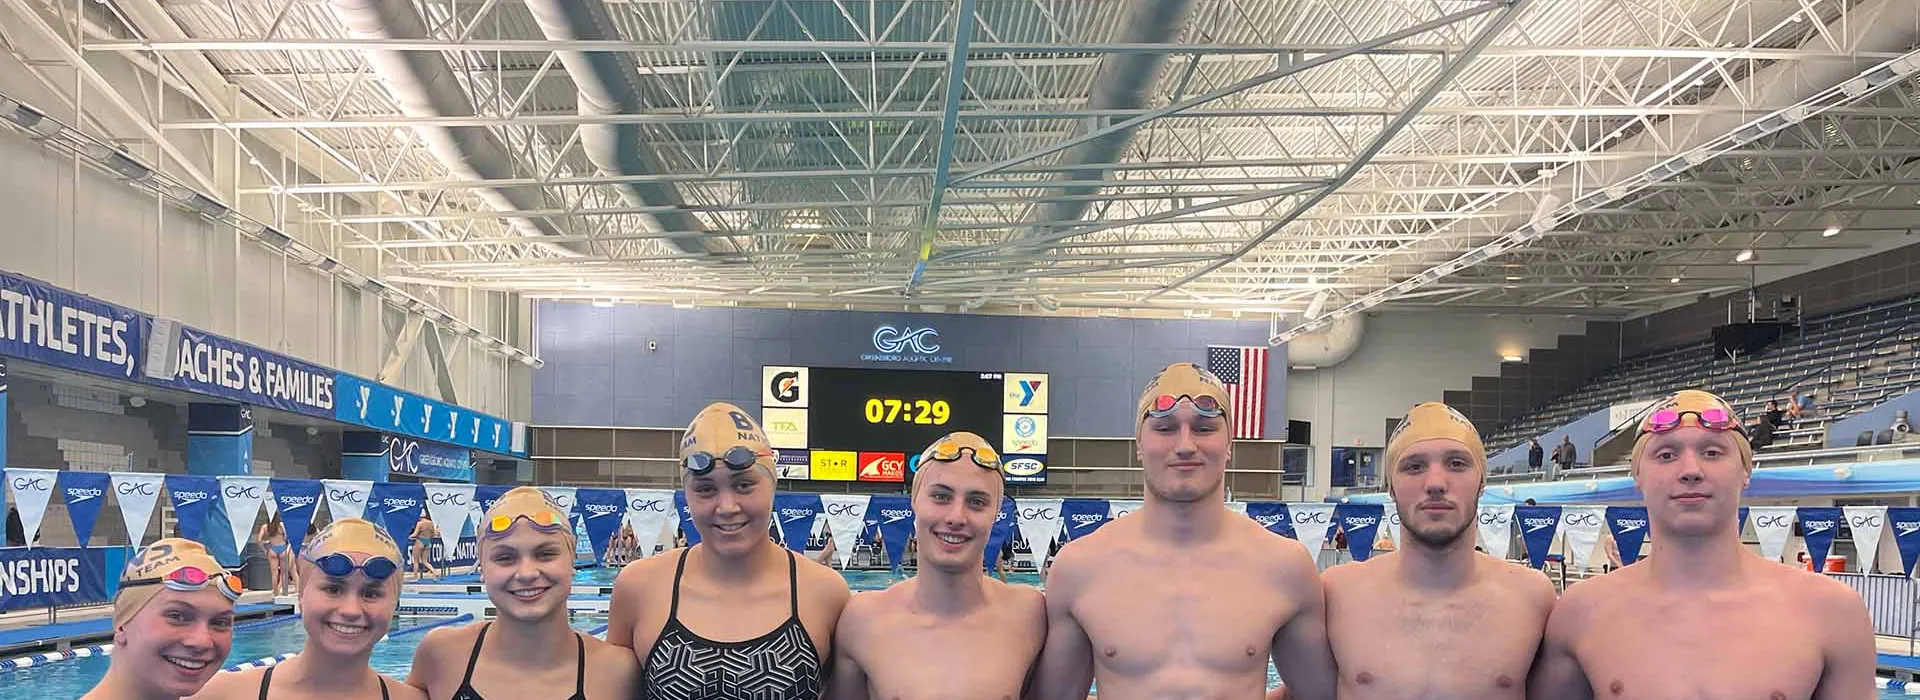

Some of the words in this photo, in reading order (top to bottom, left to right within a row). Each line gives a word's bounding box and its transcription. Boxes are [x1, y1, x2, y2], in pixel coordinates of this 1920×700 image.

[874, 326, 940, 353] GAC
[175, 339, 244, 390] ACHES
[249, 356, 262, 395] &
[266, 361, 333, 410] FAMILIES
[865, 398, 950, 425] 07:29
[882, 460, 904, 471] GCY
[1011, 462, 1038, 470] SFSC
[14, 477, 49, 491] GAC
[117, 482, 154, 496] GAC
[67, 487, 102, 498] speedo
[174, 490, 208, 500] speedo
[225, 485, 260, 499] GAC
[329, 489, 363, 503] GAC
[280, 495, 314, 505] speedo
[383, 497, 416, 507] speedo
[431, 493, 467, 506] GAC
[631, 498, 665, 512] GAC
[585, 503, 618, 514] speedo
[781, 508, 813, 517] speedo
[827, 503, 861, 516] GAC
[880, 509, 912, 519] speedo
[1022, 508, 1055, 520] GAC
[1071, 513, 1103, 522] speedo
[1295, 512, 1327, 524] GAC
[1345, 516, 1376, 525] speedo
[1480, 513, 1507, 525] GAC
[1524, 516, 1554, 526] speedo
[1565, 513, 1598, 526] GAC
[1616, 517, 1646, 528] speedo
[1757, 515, 1788, 528] GAC
[1852, 515, 1884, 528] GAC
[1805, 519, 1835, 530] speedo
[136, 556, 181, 577] TEAM
[0, 558, 80, 597] NSHIPS
